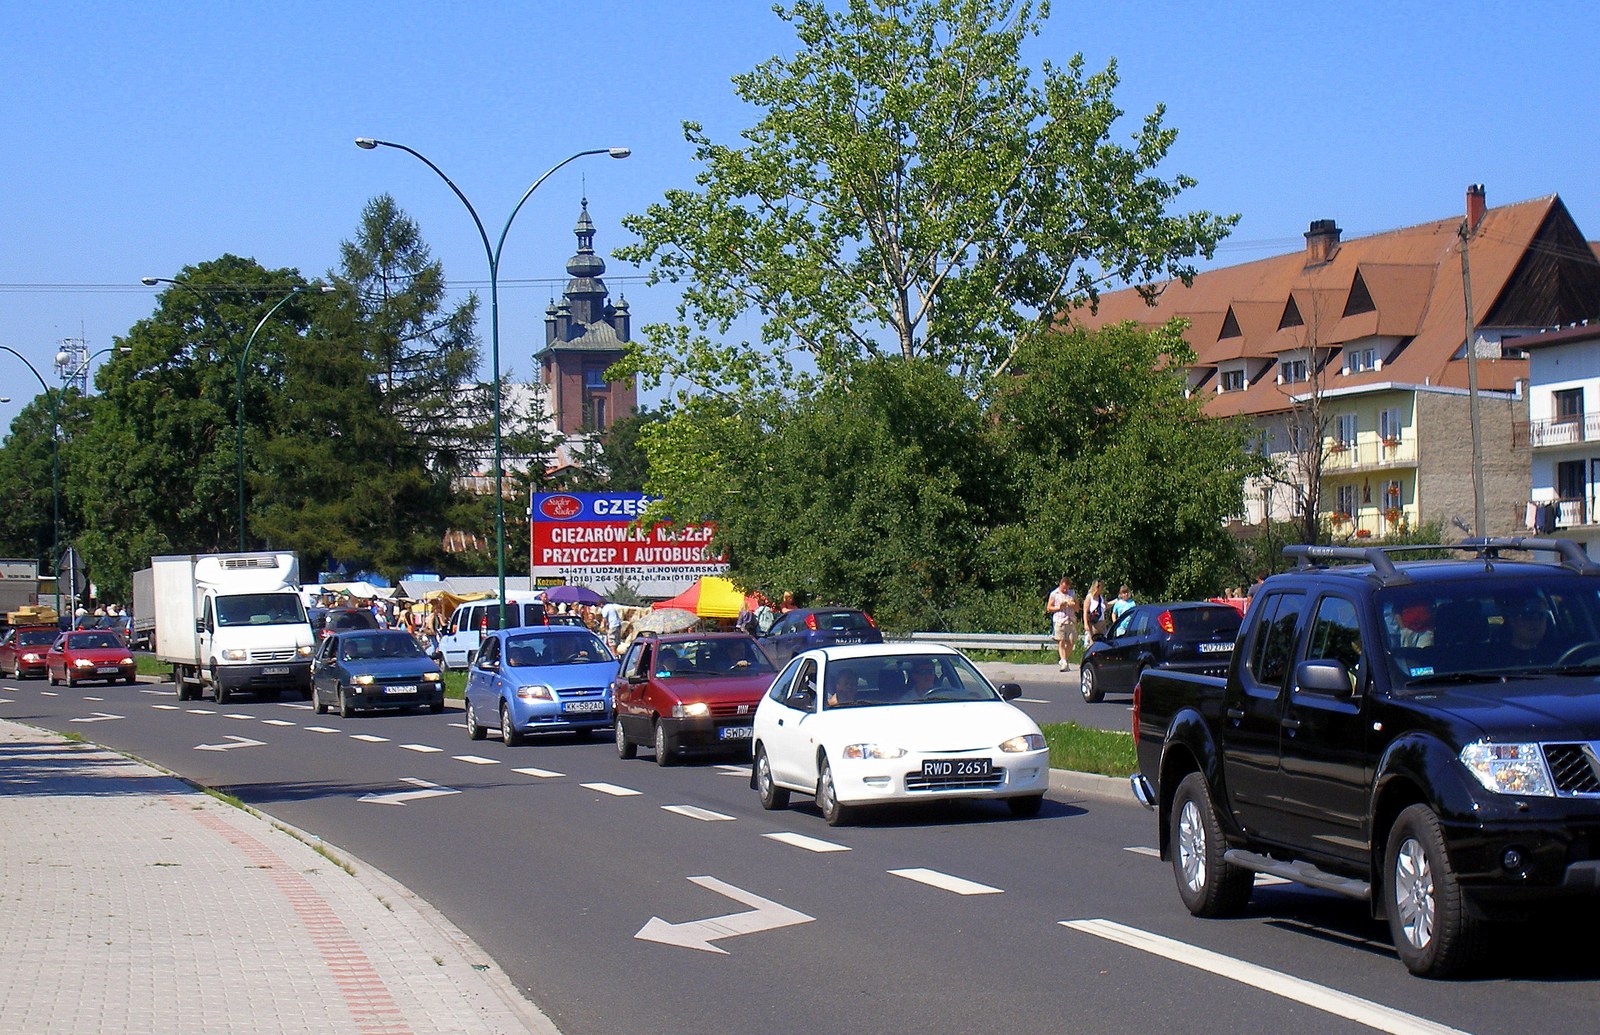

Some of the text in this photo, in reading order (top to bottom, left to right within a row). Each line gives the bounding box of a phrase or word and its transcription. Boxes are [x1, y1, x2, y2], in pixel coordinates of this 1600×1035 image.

[593, 496, 663, 516] CZĘŚ
[543, 548, 617, 563] PRZYCZEP
[623, 548, 629, 562] I
[725, 728, 745, 738] SWD
[924, 762, 988, 775] RWD 2651
